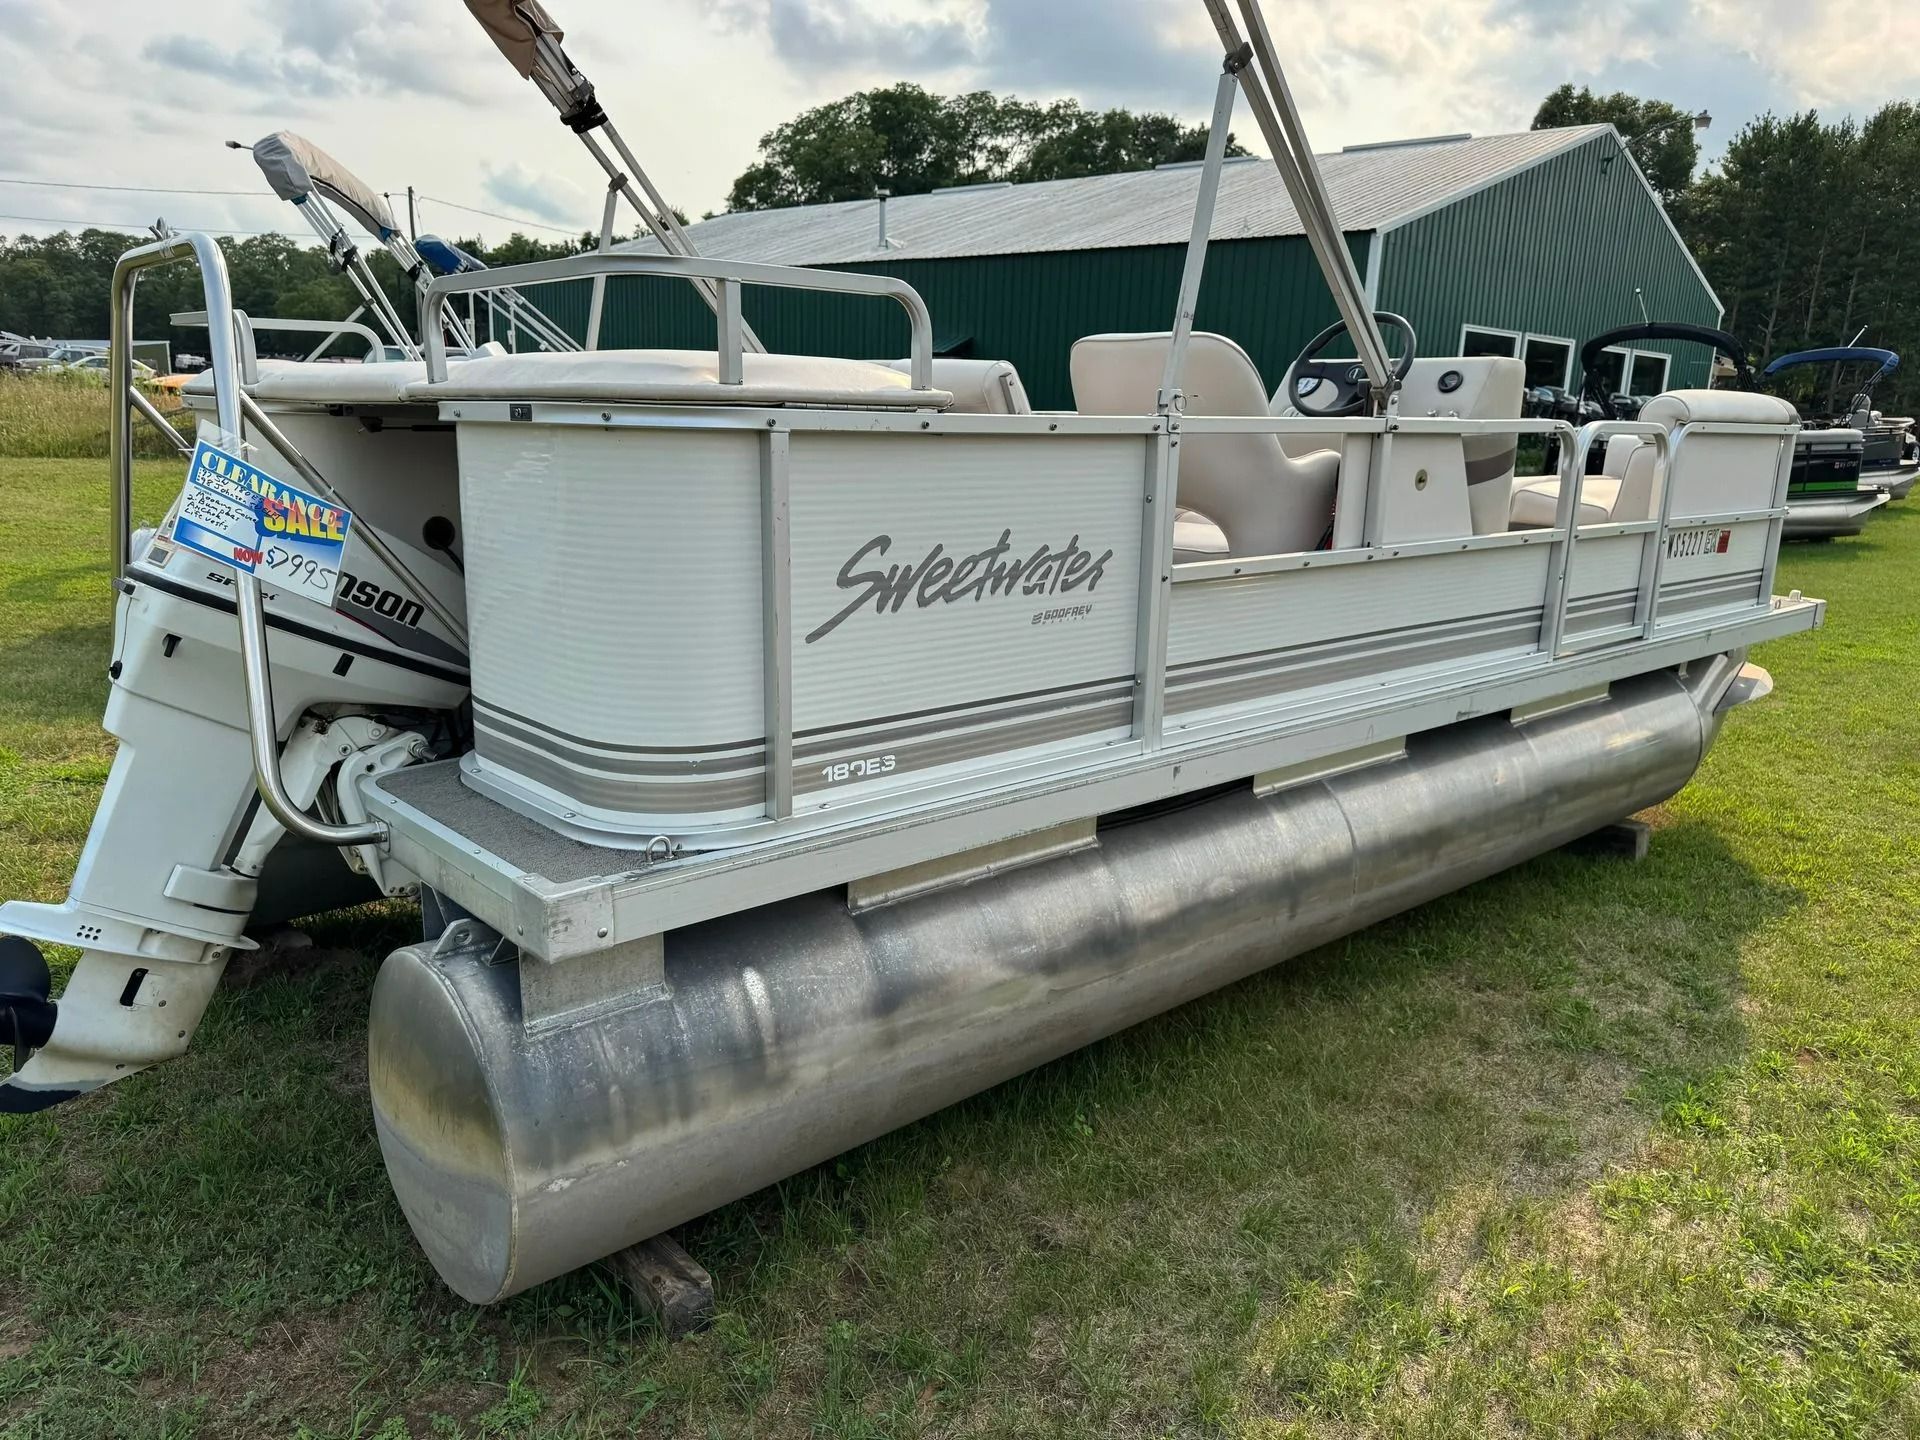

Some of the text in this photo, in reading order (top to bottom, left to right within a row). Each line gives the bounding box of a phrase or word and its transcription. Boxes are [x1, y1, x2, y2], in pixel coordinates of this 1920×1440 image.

[201, 451, 338, 528] CLEARANCE
[263, 497, 345, 542] SALE
[233, 546, 264, 565] NOW
[339, 571, 426, 628] nson
[804, 527, 1114, 645] Sweetwater
[1043, 603, 1093, 621] GODFREY
[821, 754, 897, 783] 180ES
